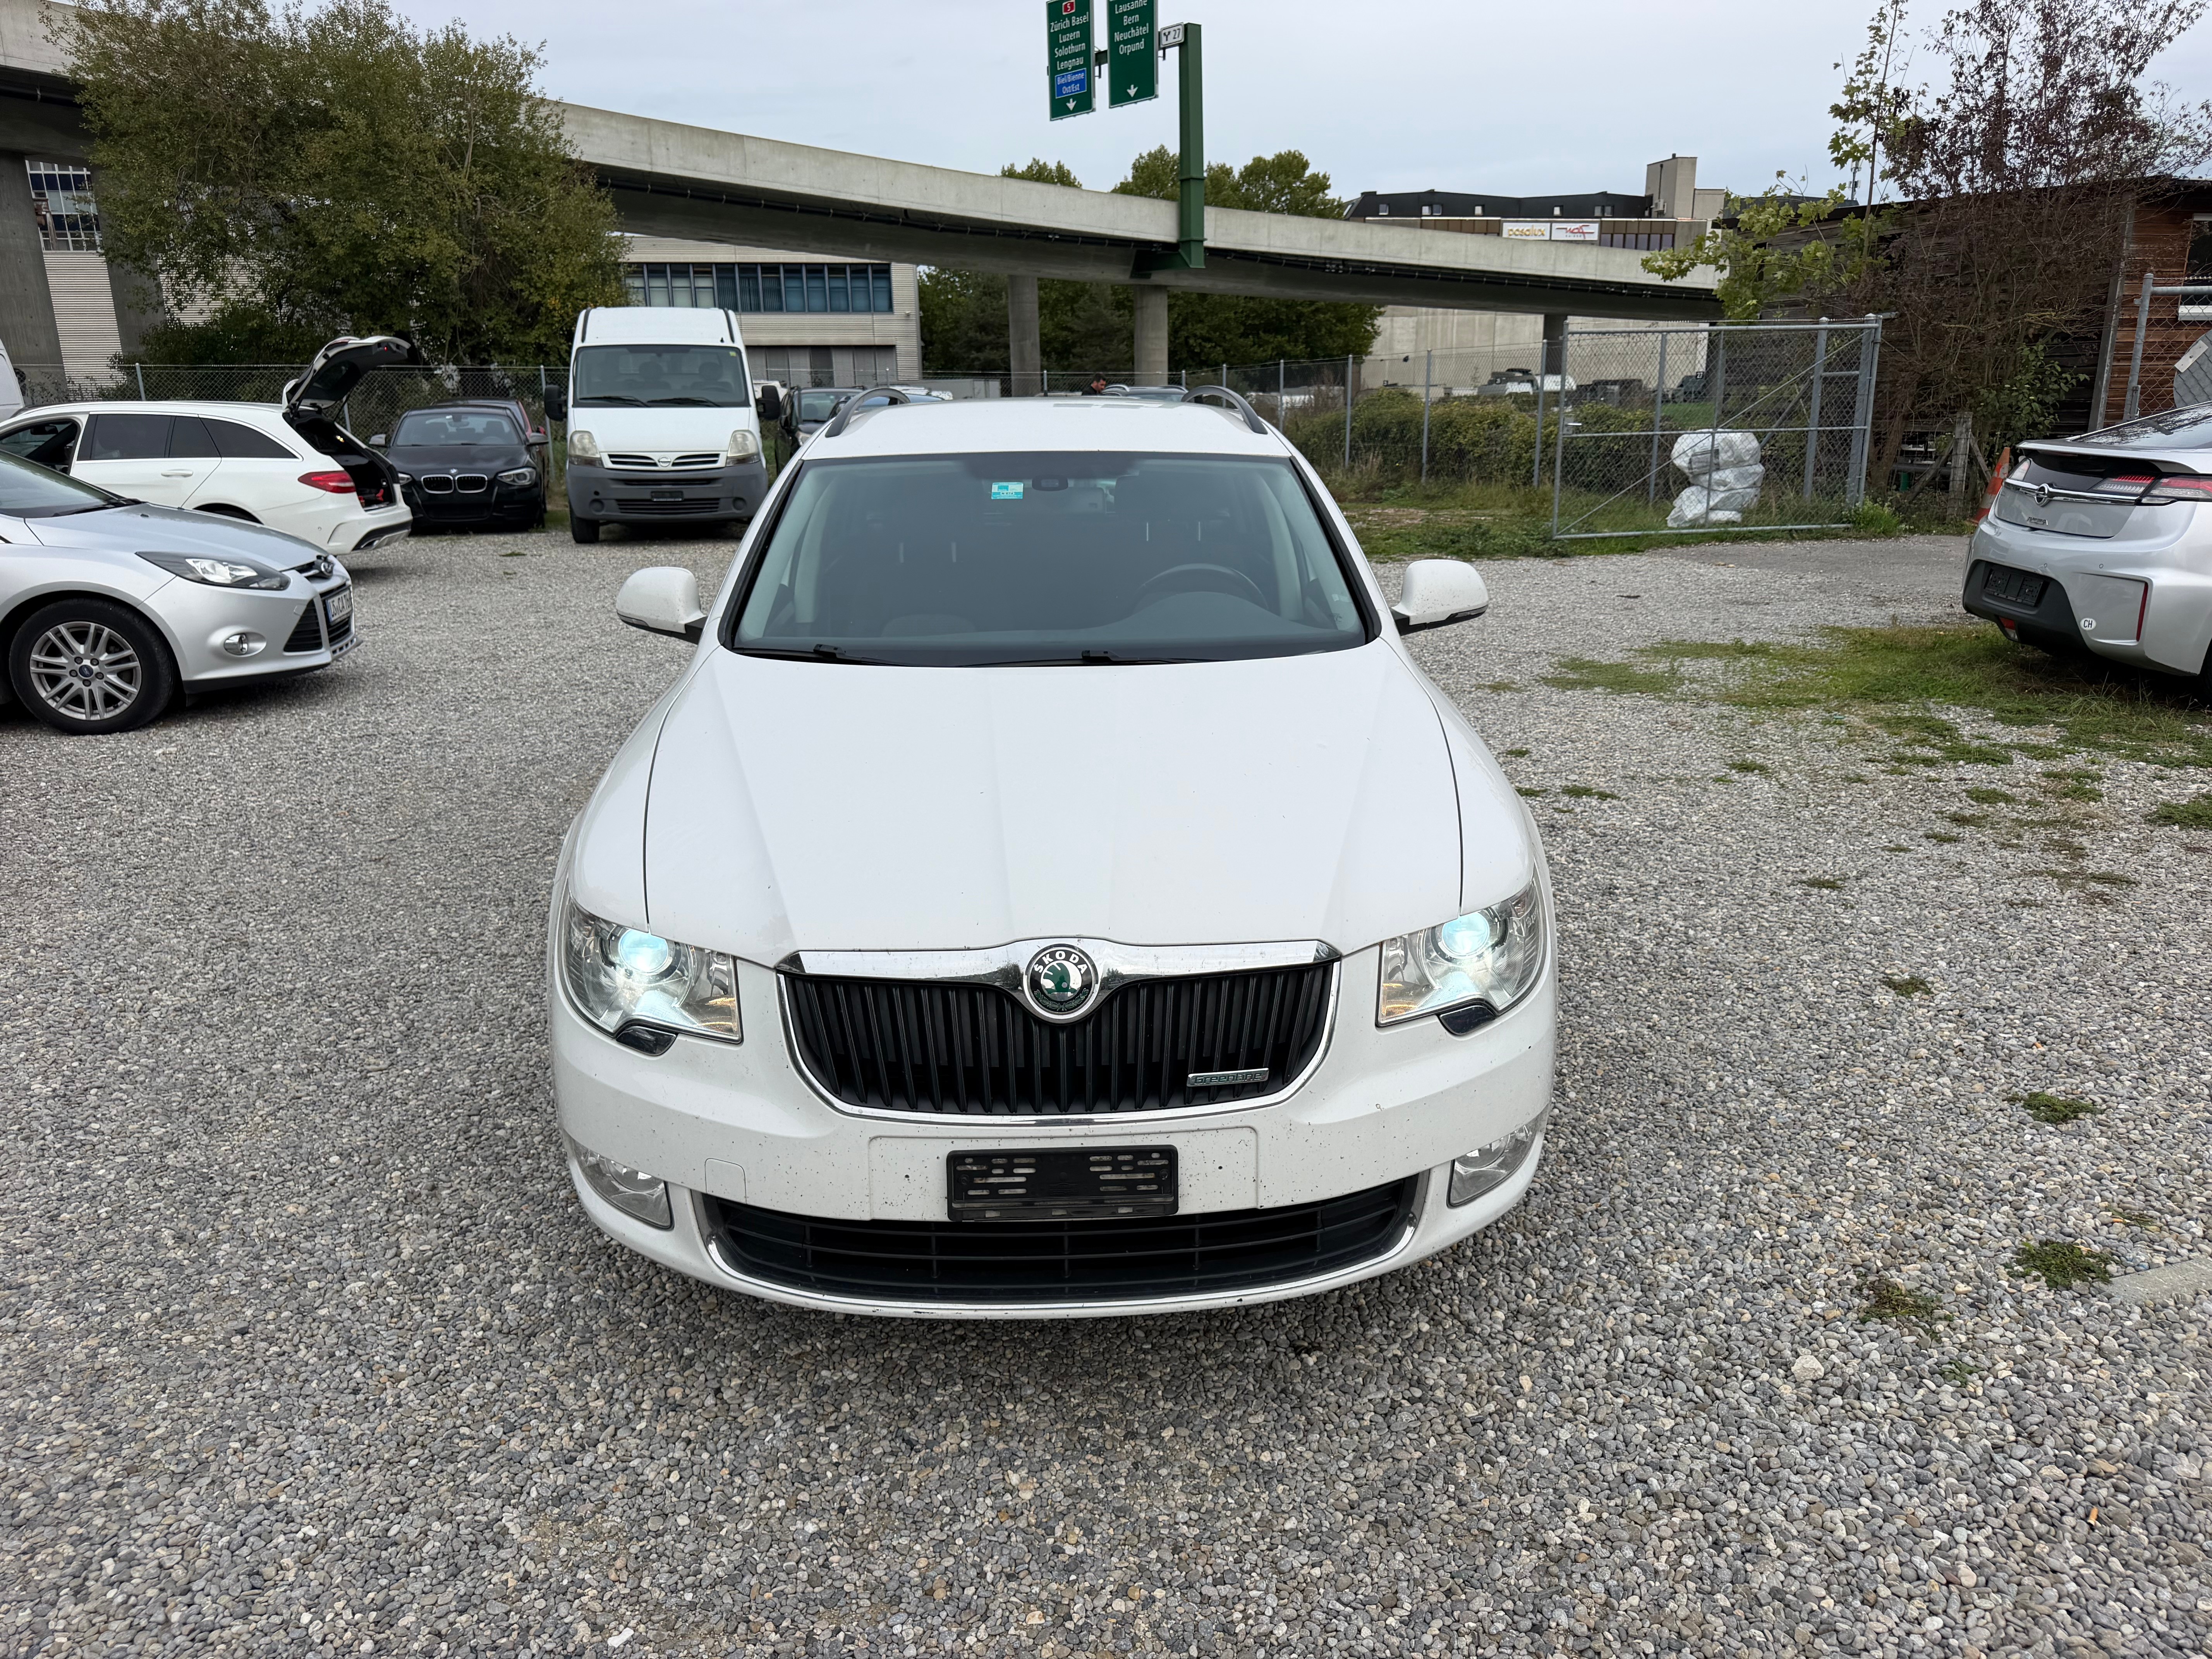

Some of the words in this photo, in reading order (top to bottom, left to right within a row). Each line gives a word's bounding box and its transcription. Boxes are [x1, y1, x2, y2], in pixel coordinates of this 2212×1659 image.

[1115, 0, 1147, 14] Lausanne
[1050, 18, 1070, 32] Zürich
[1072, 12, 1089, 26] Basel
[1123, 14, 1139, 26] Bern
[1059, 31, 1080, 43] Luzern
[1115, 23, 1149, 42] Neuchâtel
[1173, 28, 1181, 39] 27
[1054, 43, 1085, 58] Solothurn
[1119, 38, 1144, 55] Orpund
[1057, 57, 1084, 70] Lengnau
[2083, 619, 2093, 628] CH
